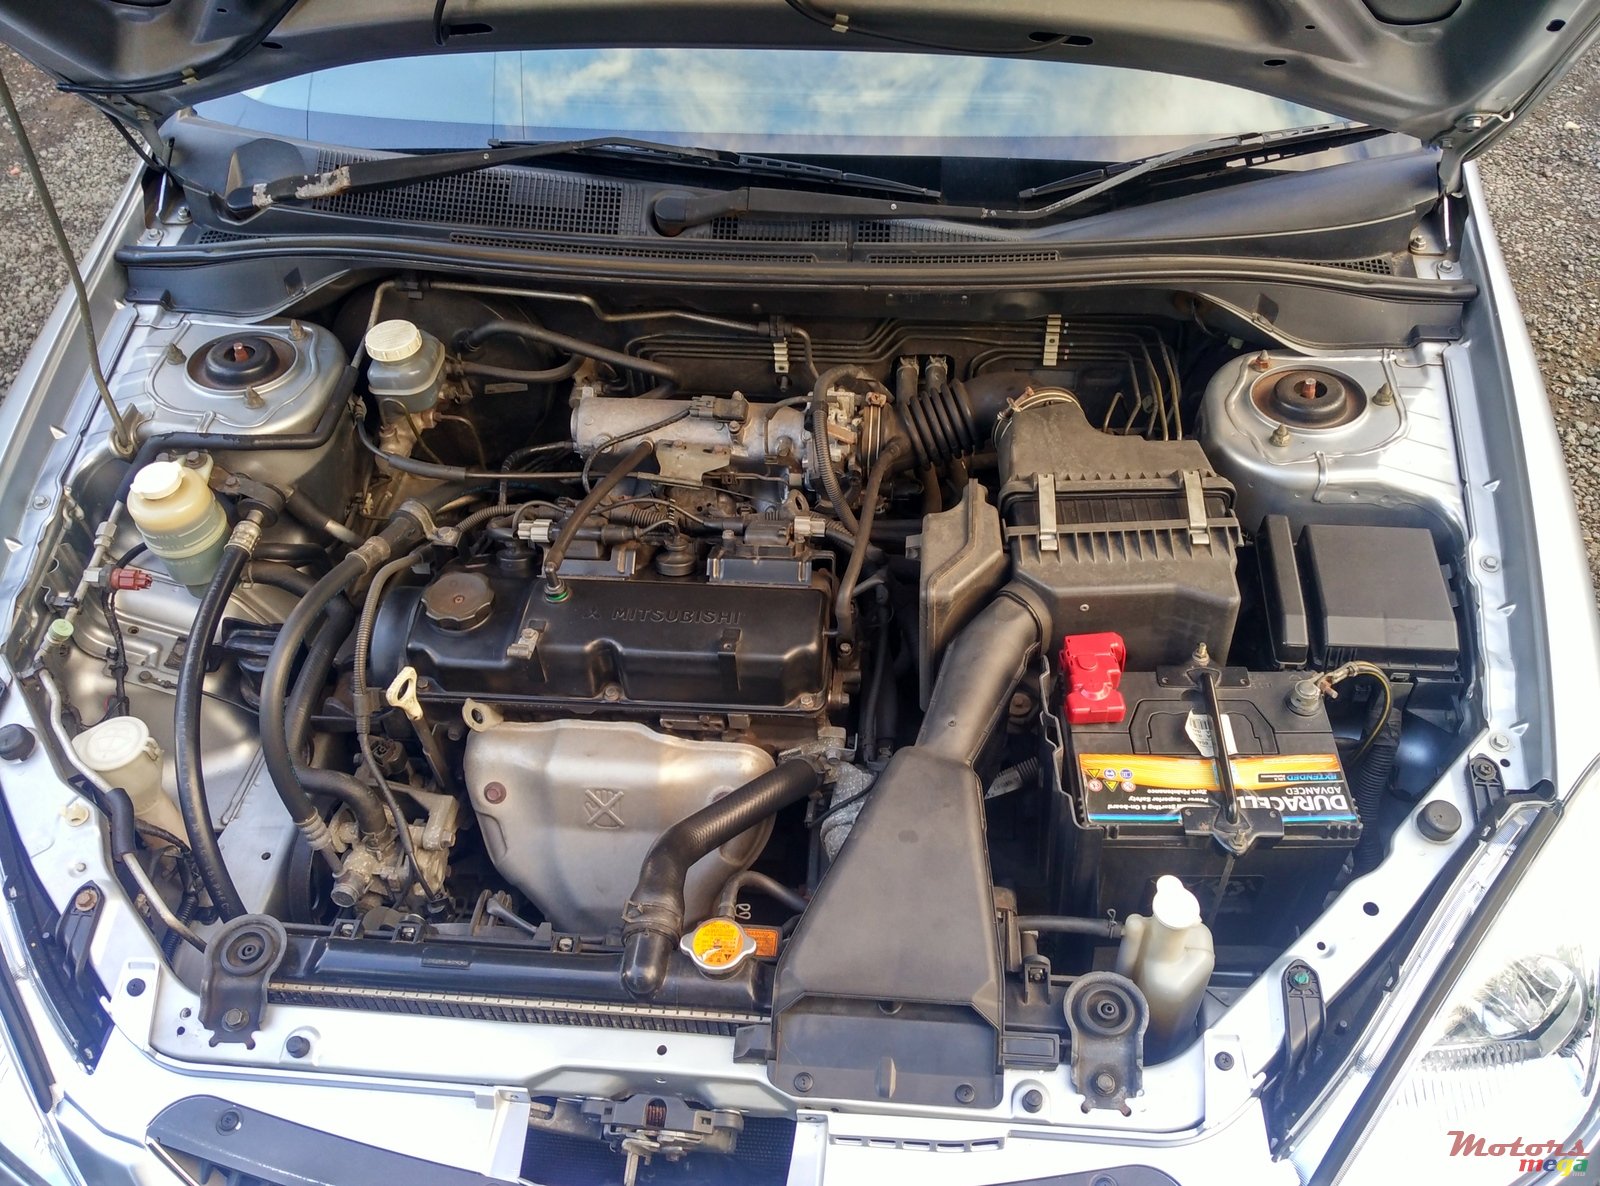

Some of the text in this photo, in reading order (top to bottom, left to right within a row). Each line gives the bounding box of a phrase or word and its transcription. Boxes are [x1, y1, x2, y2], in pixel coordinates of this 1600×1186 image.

[611, 607, 742, 625] MITSUBISHI
[1287, 773, 1338, 782] EXTENDED
[1285, 786, 1342, 796] ADVANCED
[1237, 795, 1348, 812] DURACELL
